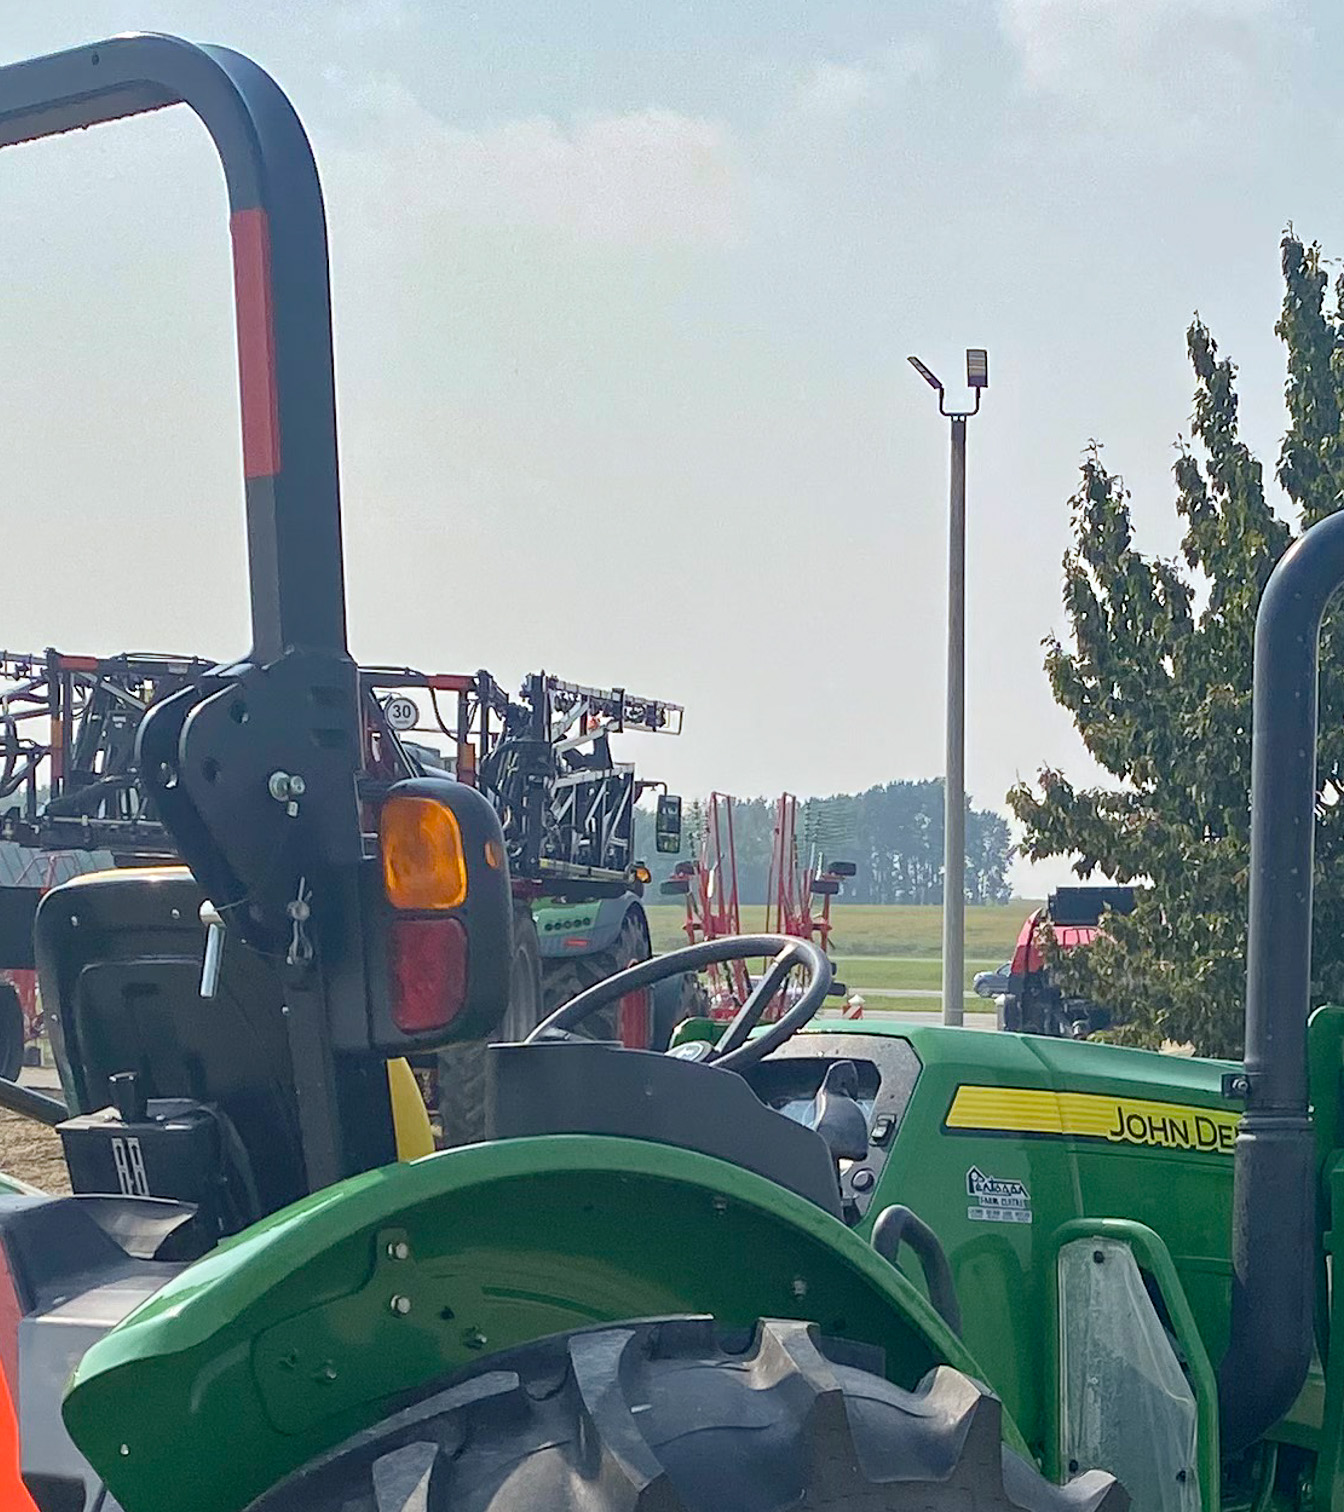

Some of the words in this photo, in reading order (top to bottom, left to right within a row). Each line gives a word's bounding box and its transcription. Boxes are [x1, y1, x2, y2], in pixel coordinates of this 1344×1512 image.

[392, 704, 411, 719] 30
[1110, 1106, 1190, 1145] JOHN
[1194, 1115, 1240, 1149] DE
